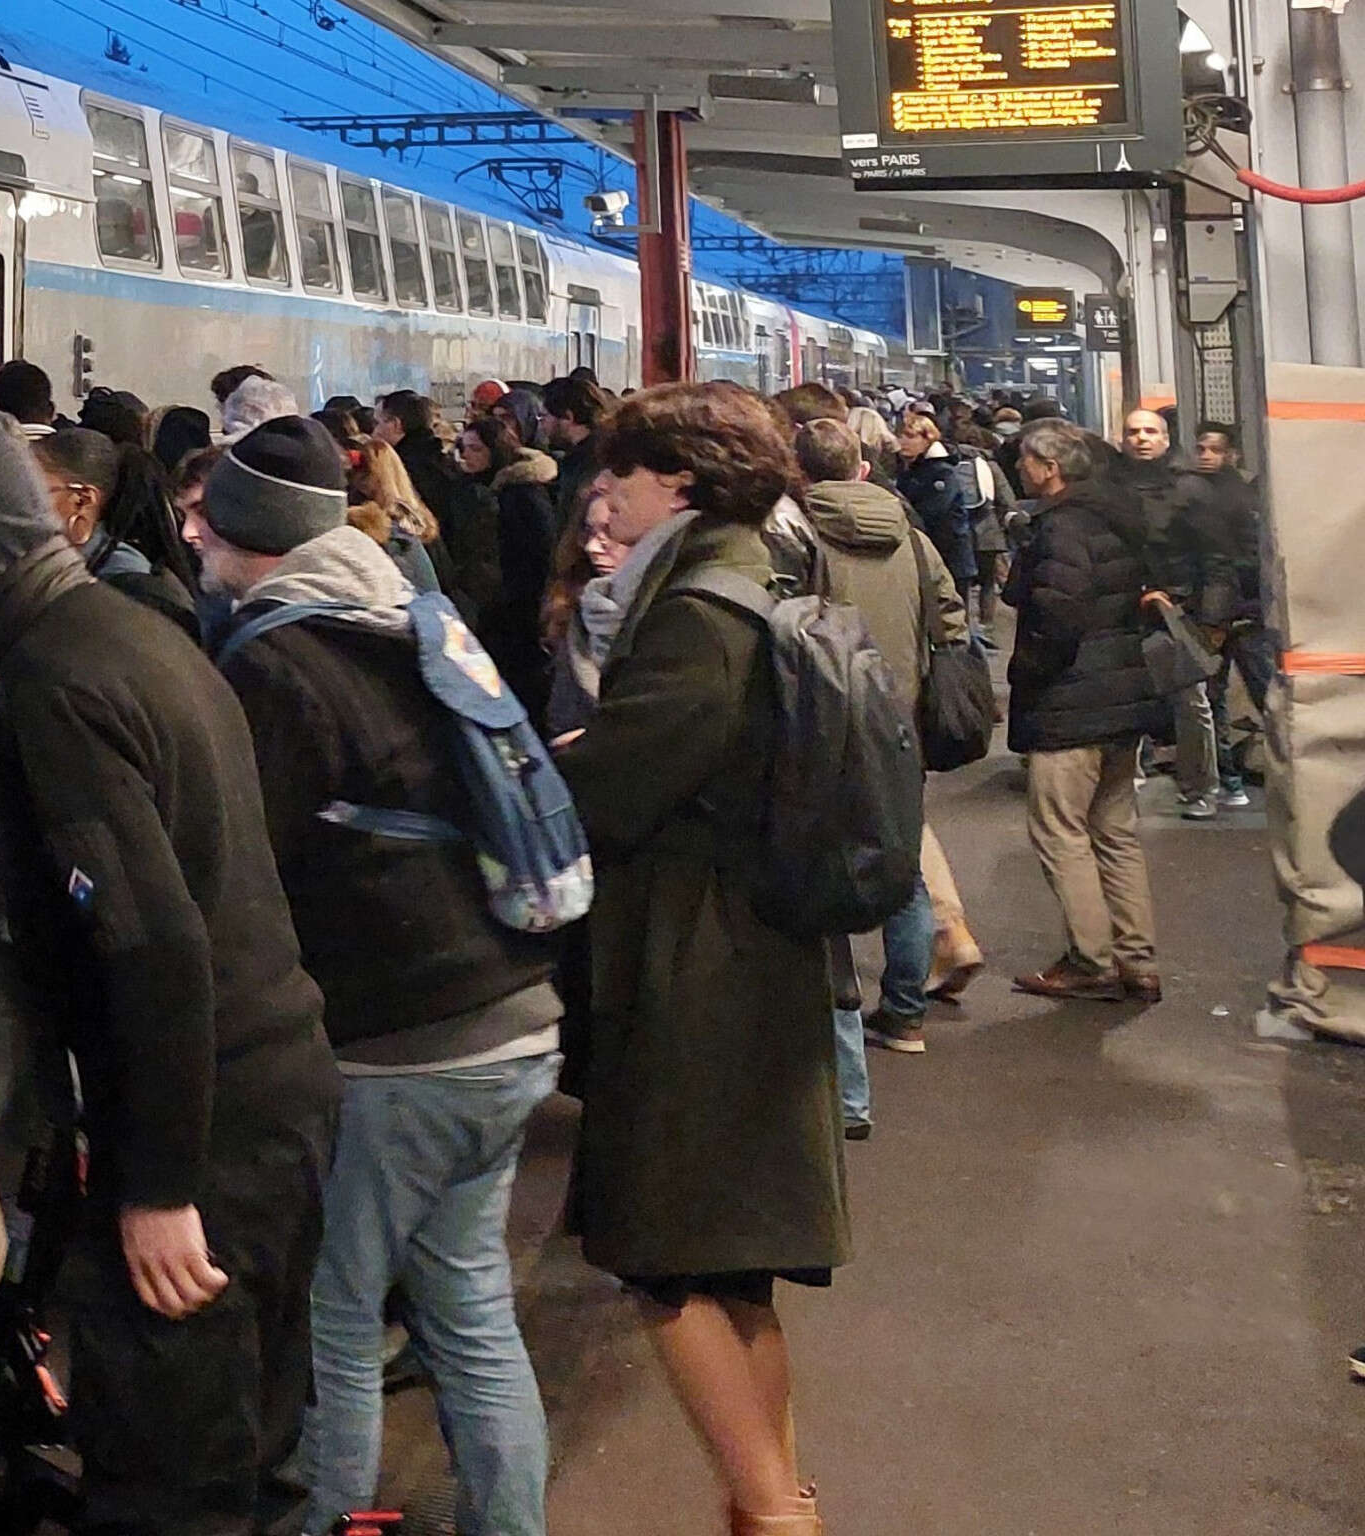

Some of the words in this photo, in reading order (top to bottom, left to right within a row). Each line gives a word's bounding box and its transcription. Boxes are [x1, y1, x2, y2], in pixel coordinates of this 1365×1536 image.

[850, 157, 879, 168] vers
[881, 153, 921, 166] PARIS
[863, 169, 888, 178] PARIS
[902, 167, 926, 177] PARIS
